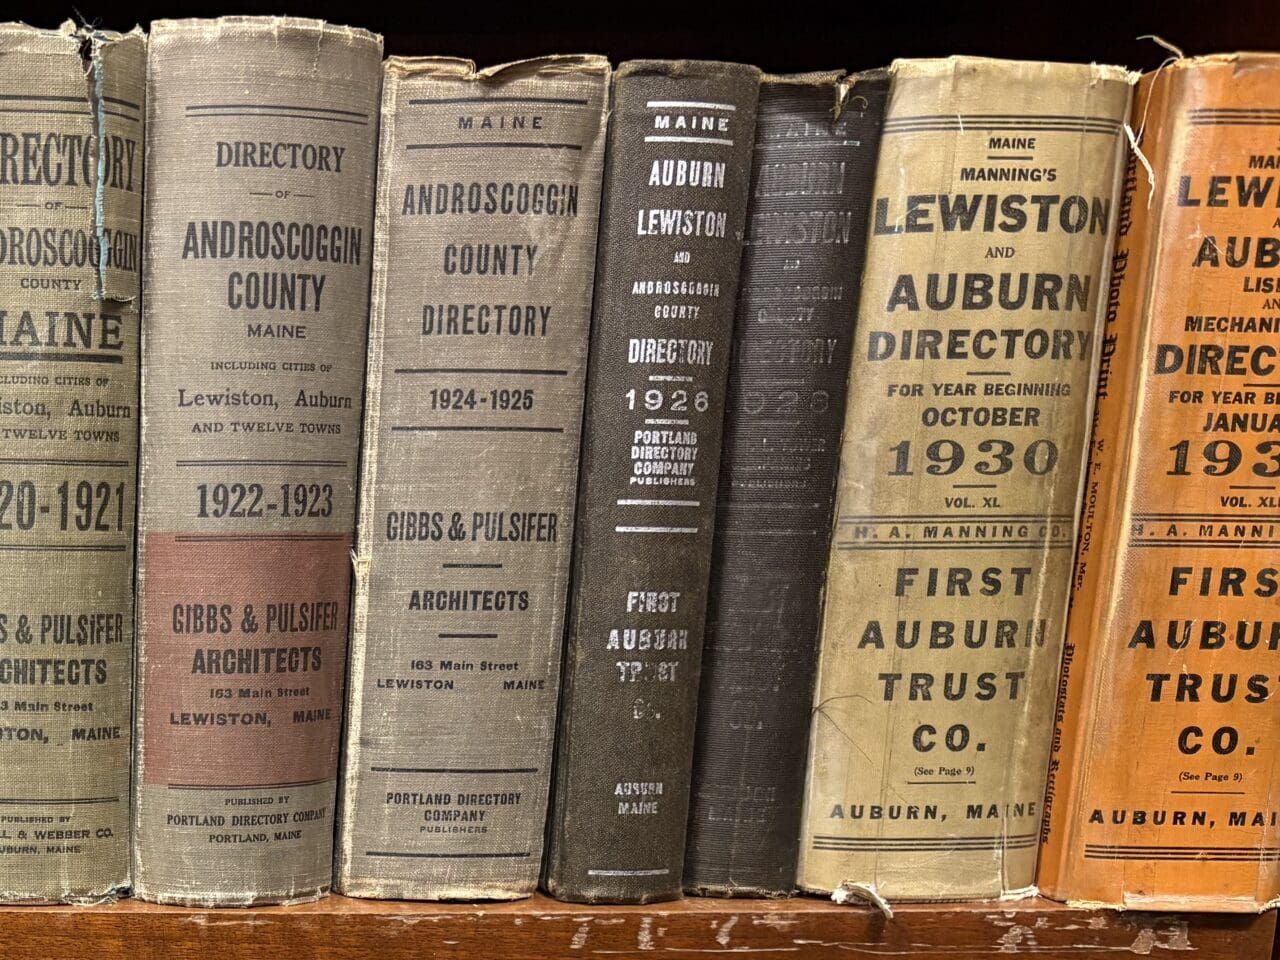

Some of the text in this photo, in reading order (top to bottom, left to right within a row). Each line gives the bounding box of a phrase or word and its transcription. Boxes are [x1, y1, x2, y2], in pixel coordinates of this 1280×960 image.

[459, 116, 542, 129] MAINE
[655, 116, 728, 131] MAINE
[989, 138, 1036, 149] MAINE
[215, 141, 346, 172] DIRECTORY
[961, 168, 1057, 182] MANNING'S
[402, 183, 579, 217] ANDROSCOGGIN
[637, 209, 726, 237] LEWISTON
[874, 194, 1109, 236] LEWISTON
[182, 220, 362, 265] ANDROSCOGGIN
[20, 278, 83, 291] COUNTY
[886, 273, 1092, 312] AUBURN
[423, 305, 552, 336] DIRECTORY
[628, 338, 711, 364] DIRECTORY
[867, 329, 1092, 362] DIRECTORY
[430, 389, 534, 411] 1924-1925
[888, 382, 1071, 398] FOR YEAR BEGINNING
[922, 407, 1040, 427] OCTOBER
[197, 482, 333, 518] 1922-1923
[945, 497, 1001, 508] VOL. XL
[409, 590, 529, 611] ARCHITECTS
[411, 660, 519, 671] 163 Main Street
[72, 726, 121, 741] MAINE
[914, 766, 975, 776] (See Page 9)
[618, 802, 657, 814] MAINE
[831, 802, 1036, 822] AUBURN, MAINE
[1089, 810, 1214, 828] AUBURN,
[209, 830, 302, 843] PORTLAND, MAINE
